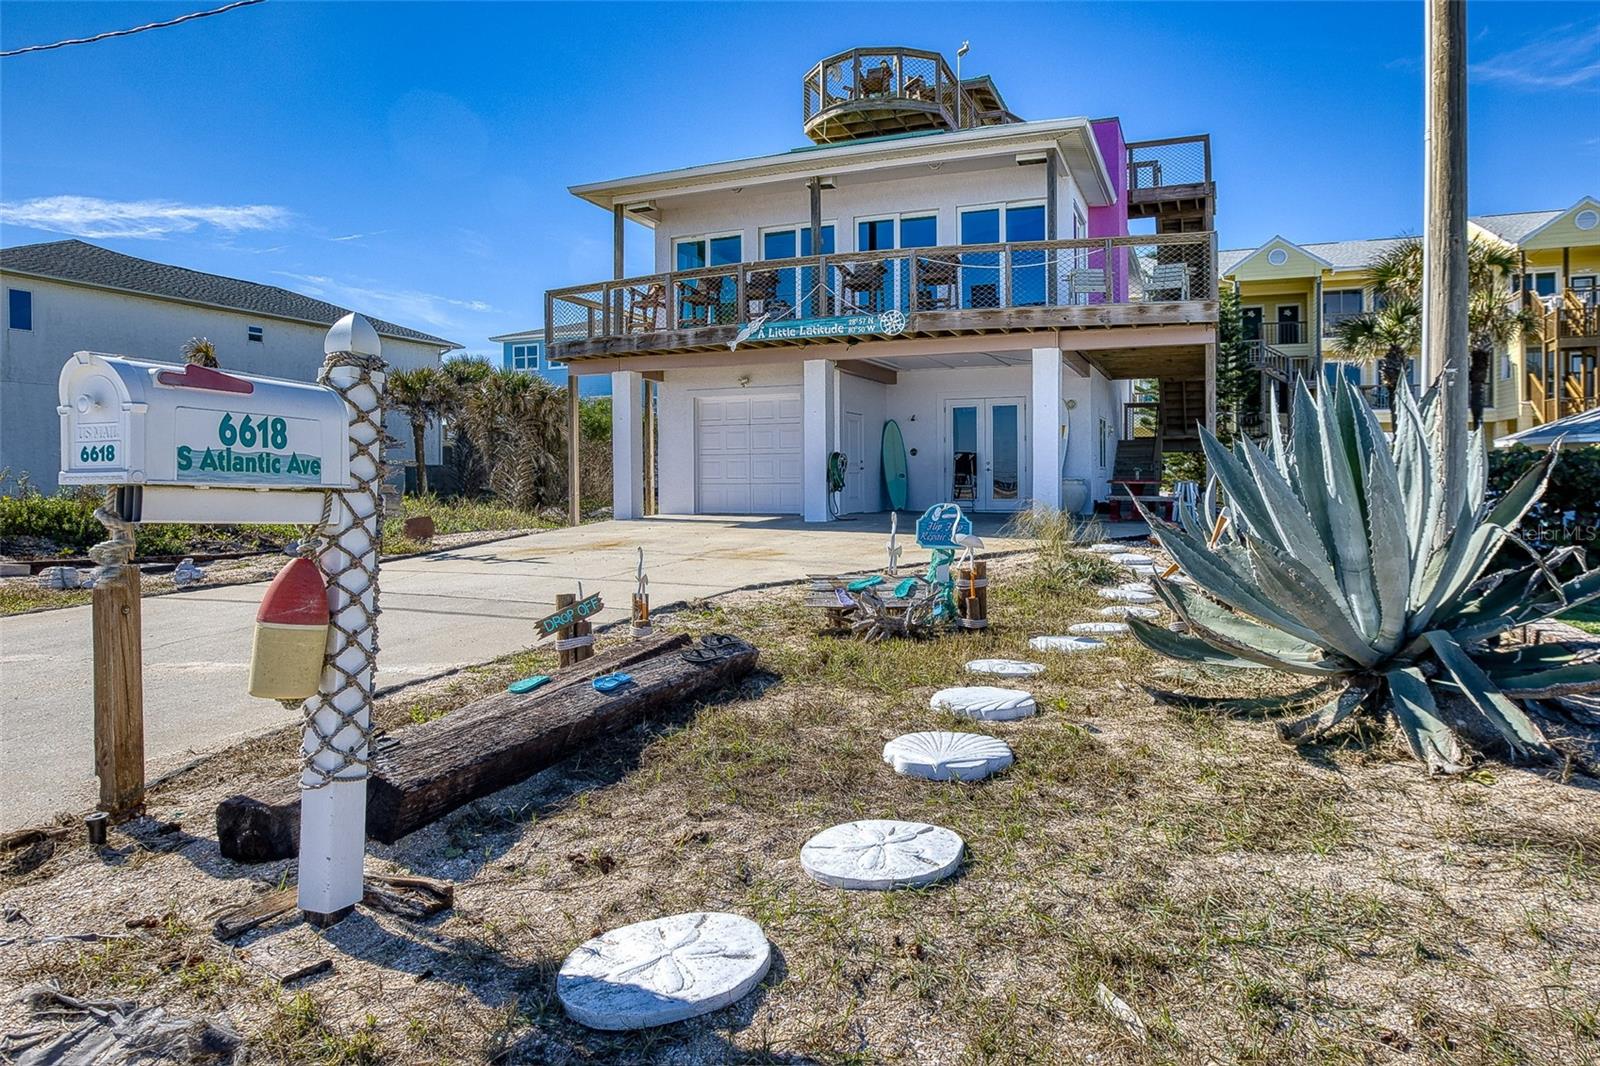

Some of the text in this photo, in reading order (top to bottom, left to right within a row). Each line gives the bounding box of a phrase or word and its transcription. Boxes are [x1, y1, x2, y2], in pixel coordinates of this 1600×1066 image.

[757, 323, 845, 339] A Little Latitude
[218, 412, 288, 450] 6618
[80, 444, 115, 462] 6618
[177, 446, 321, 475] S Atlantic Ave
[543, 597, 598, 632] DROP OFF
